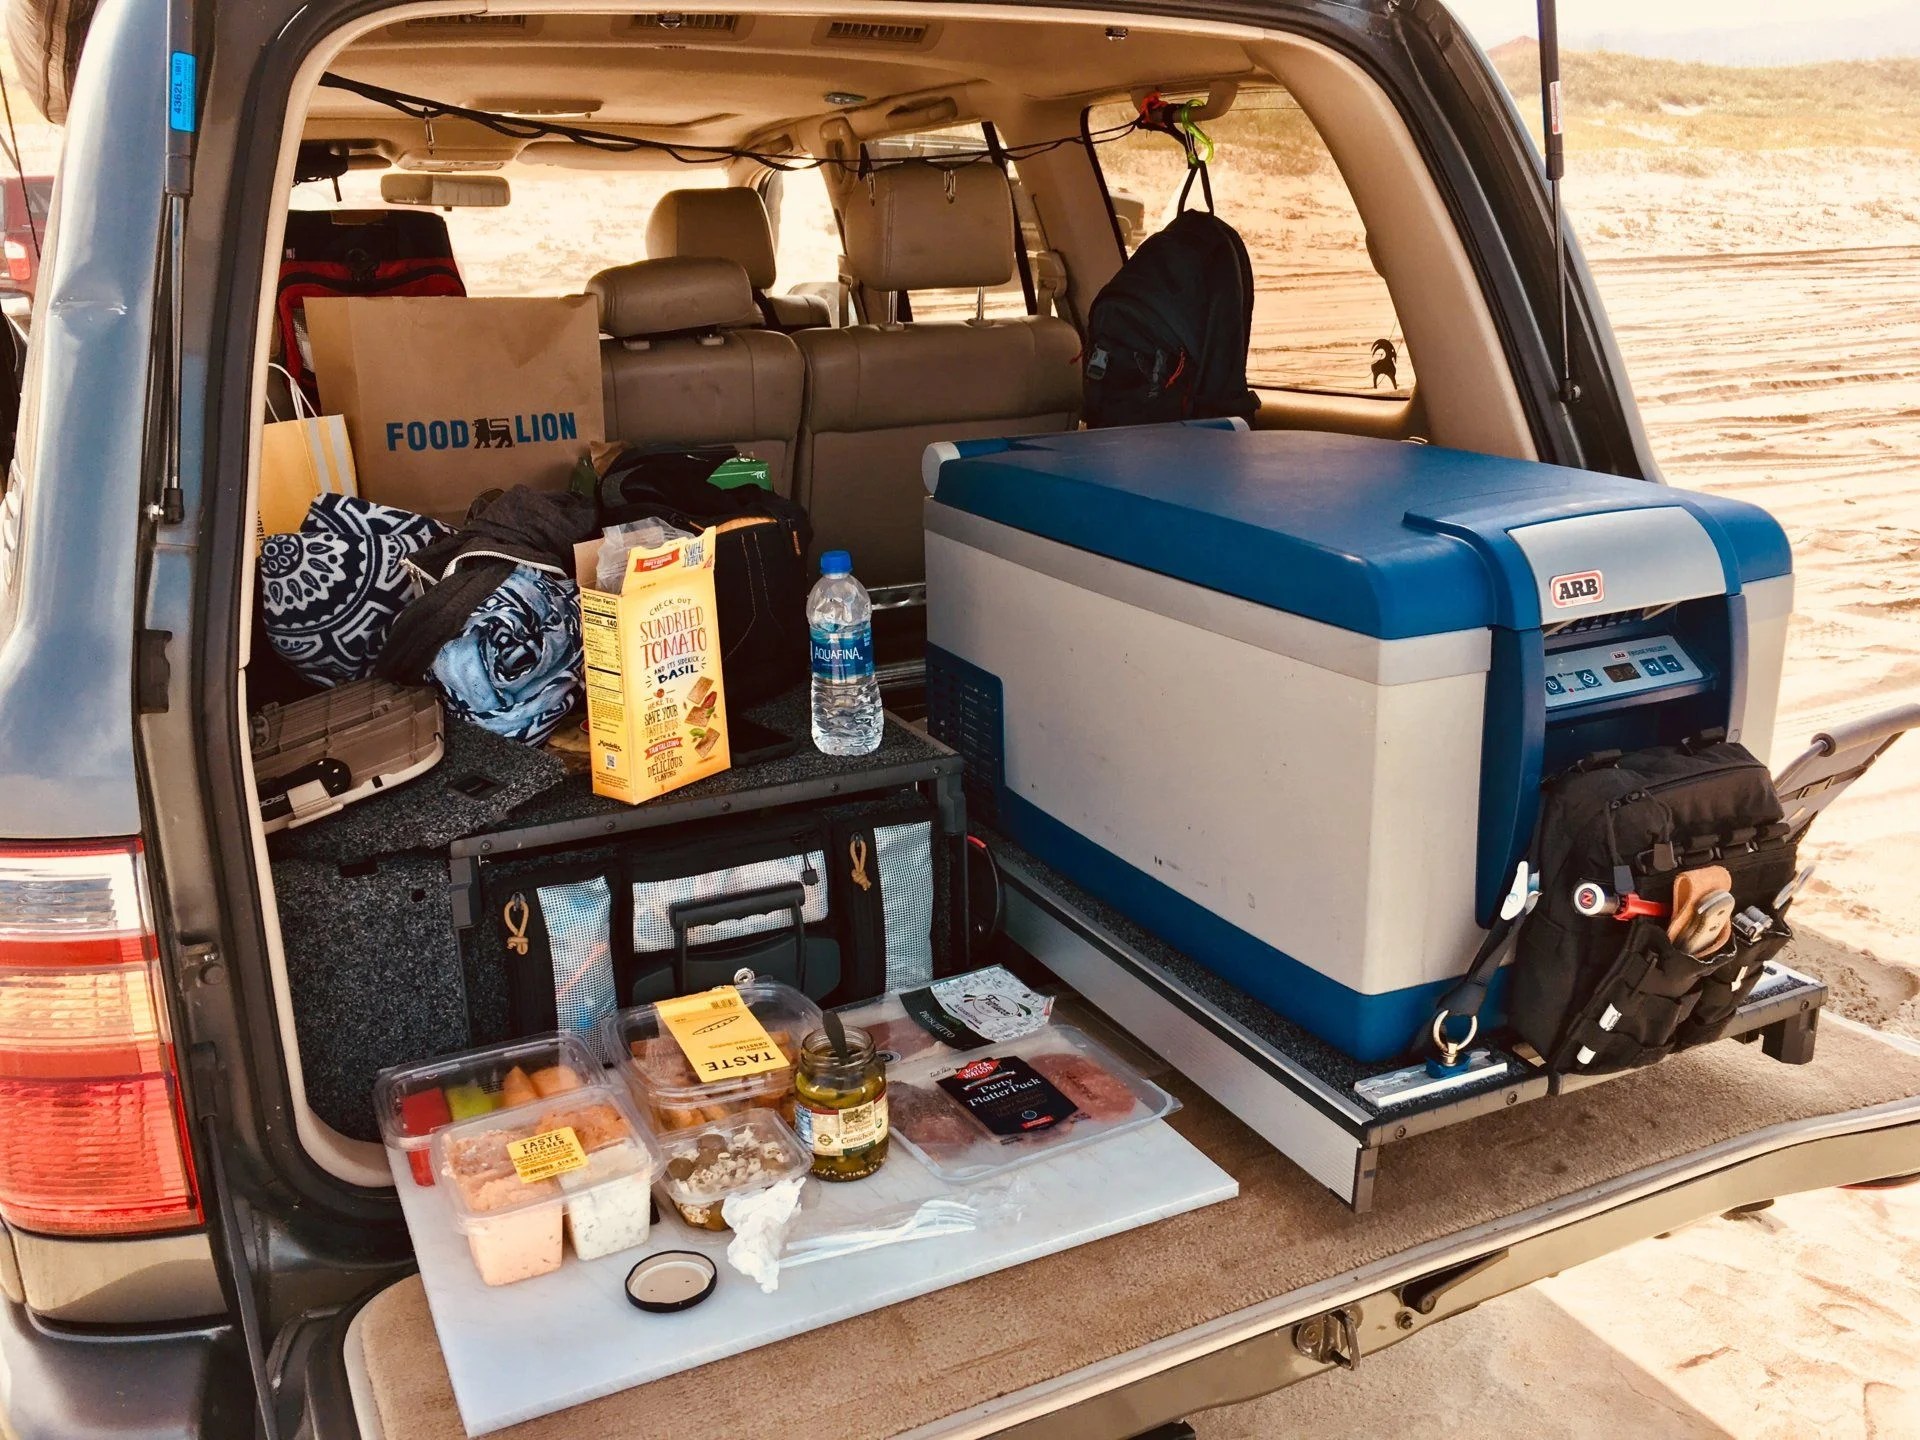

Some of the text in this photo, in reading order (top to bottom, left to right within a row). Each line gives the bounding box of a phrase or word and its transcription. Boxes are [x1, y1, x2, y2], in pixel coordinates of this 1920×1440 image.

[386, 412, 577, 451] FOOD LION
[1558, 578, 1598, 600] ARB
[649, 597, 692, 616] CHECK OUT
[606, 619, 618, 628] 140
[640, 606, 704, 642] SUNDRIED
[640, 627, 707, 670] TOMATO
[814, 646, 861, 662] AQUAFINA
[657, 664, 699, 685] BASIL
[644, 705, 661, 727] SAVE
[647, 756, 684, 778] DELICIOUS
[704, 1051, 776, 1072] TASTE
[967, 1077, 1042, 1107] Platter Pack
[977, 1078, 1014, 1094] Party
[521, 1134, 561, 1150] TASTE
[524, 1140, 565, 1154] KITCHEN
